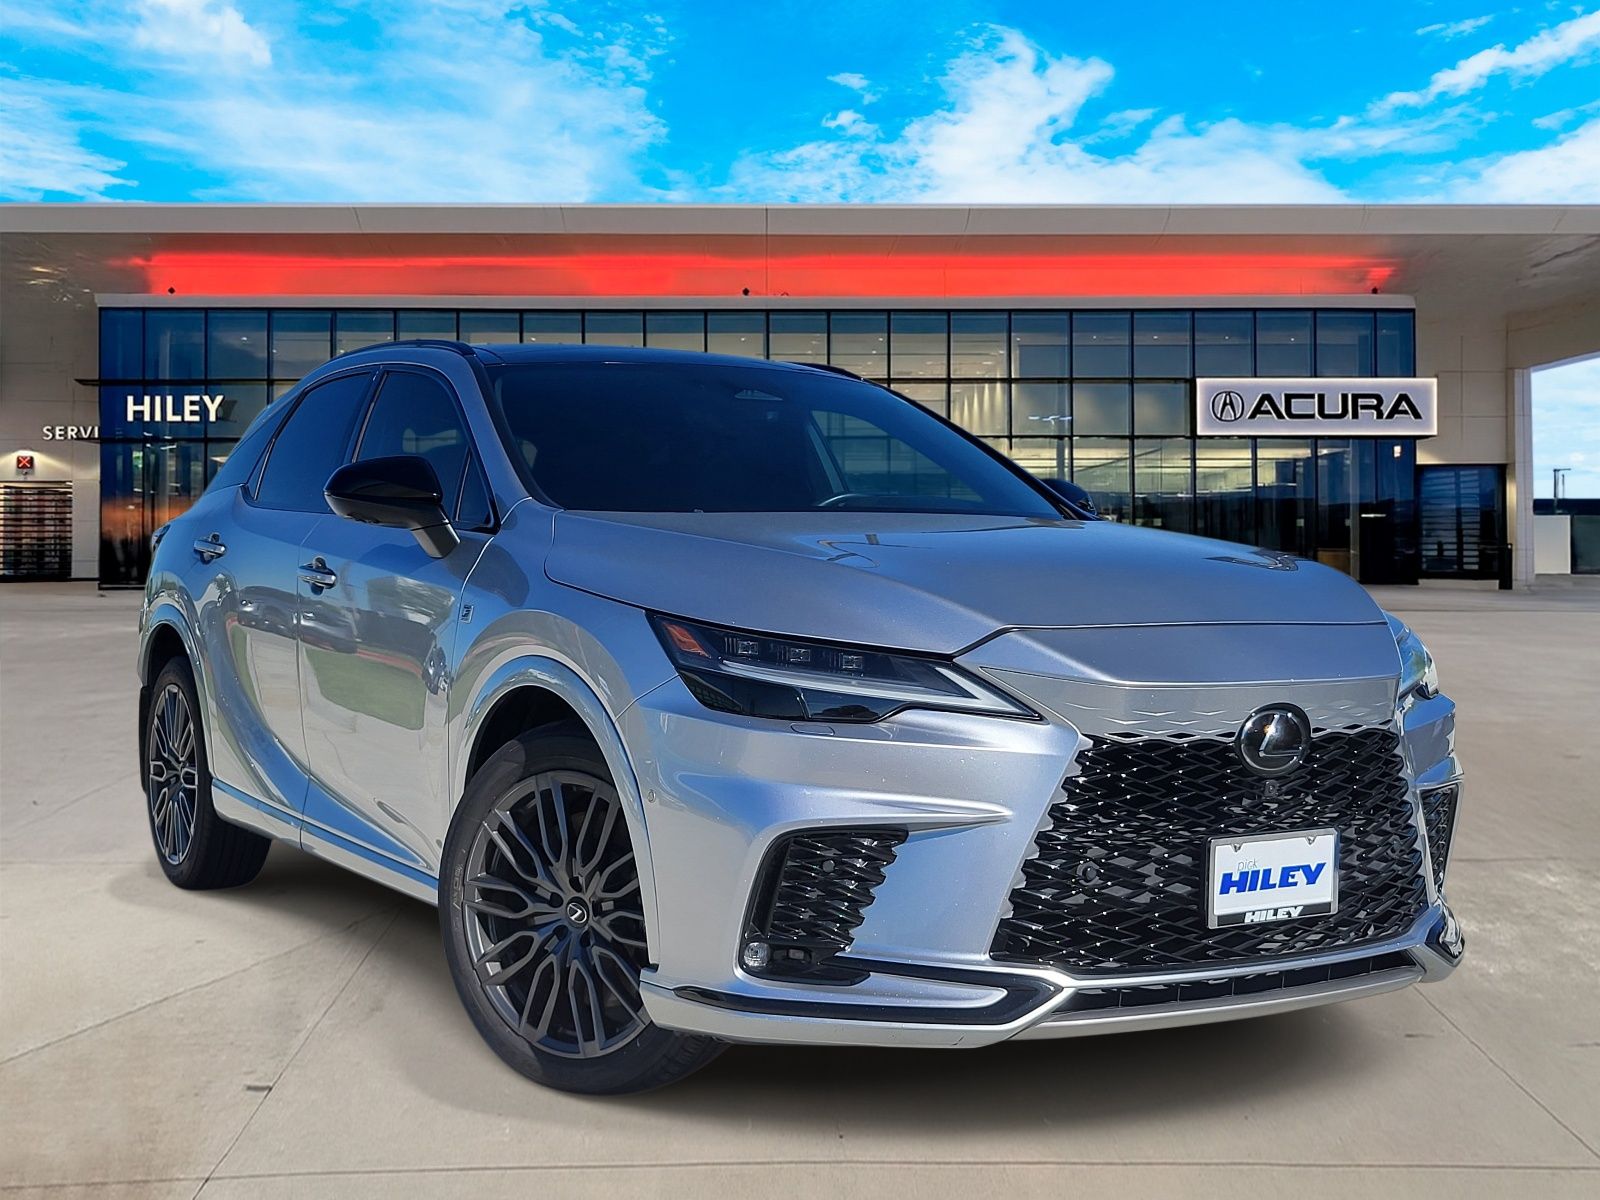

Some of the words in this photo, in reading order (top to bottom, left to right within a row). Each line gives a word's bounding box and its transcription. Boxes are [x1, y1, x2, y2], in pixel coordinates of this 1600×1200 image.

[126, 395, 223, 422] HILEY
[1248, 393, 1422, 419] ACURA
[1219, 862, 1327, 895] HILEY
[1244, 906, 1304, 923] HILEY
